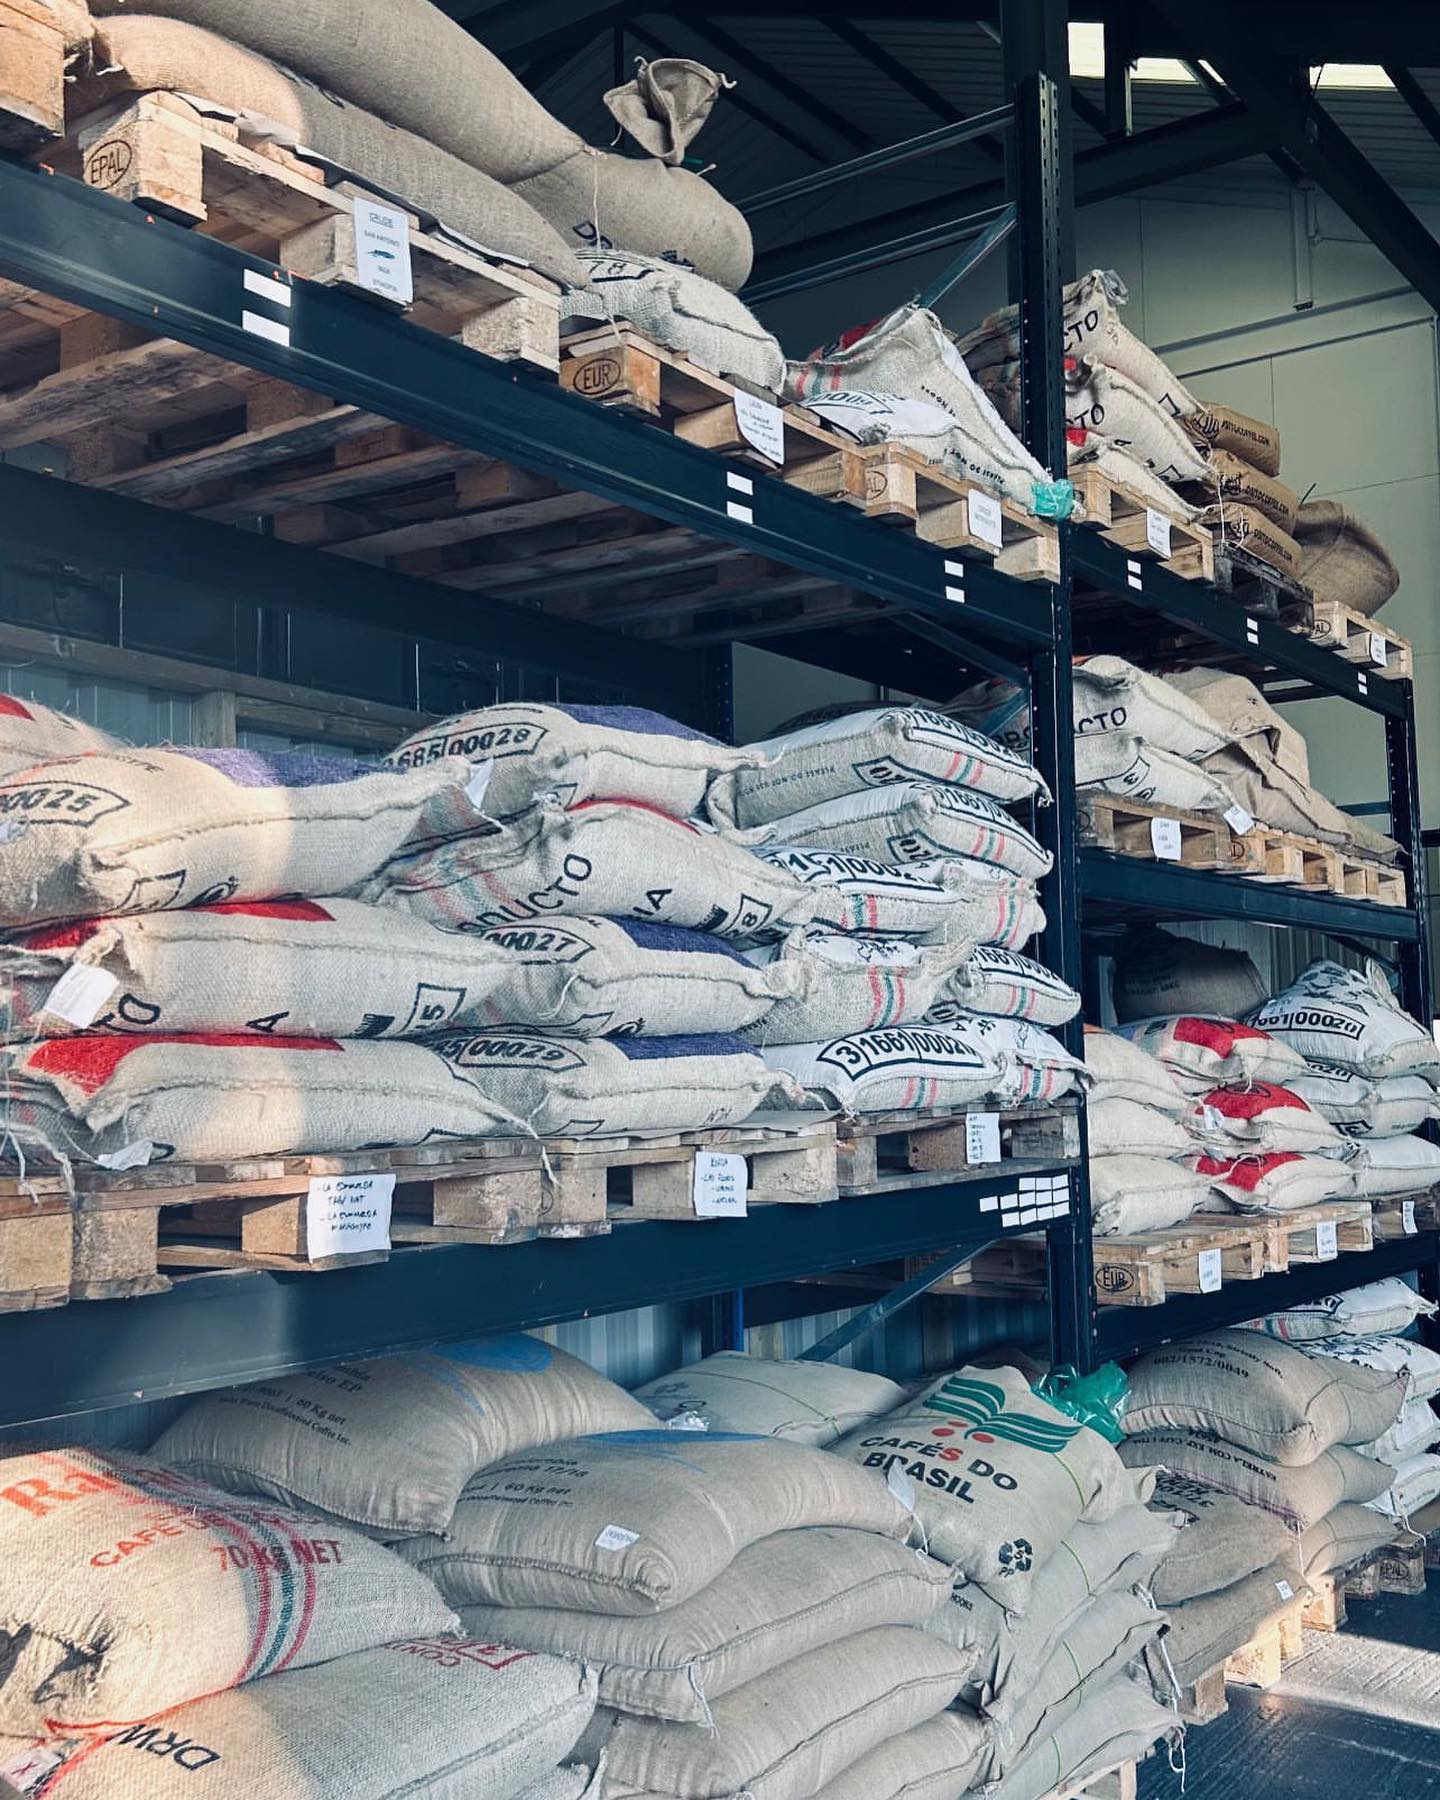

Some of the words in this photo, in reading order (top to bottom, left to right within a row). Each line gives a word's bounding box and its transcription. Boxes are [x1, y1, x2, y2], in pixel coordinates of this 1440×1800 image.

[90, 147, 125, 184] EPAL
[583, 363, 613, 390] EUR
[448, 728, 531, 756] 00028
[1295, 1012, 1358, 1035] 00020
[468, 1039, 565, 1062] 00029
[835, 1045, 861, 1065] 3
[859, 1032, 915, 1056] 1661
[1102, 1268, 1128, 1288] EUR
[312, 1404, 328, 1419] Kg
[327, 1412, 347, 1426] net
[312, 1422, 336, 1439] Coffee
[859, 1436, 964, 1462] CAFÉS
[967, 1458, 1019, 1491] DO
[504, 1482, 525, 1495] 60
[546, 1485, 573, 1496] net
[211, 1542, 250, 1571] 70
[289, 1539, 343, 1566] NET
